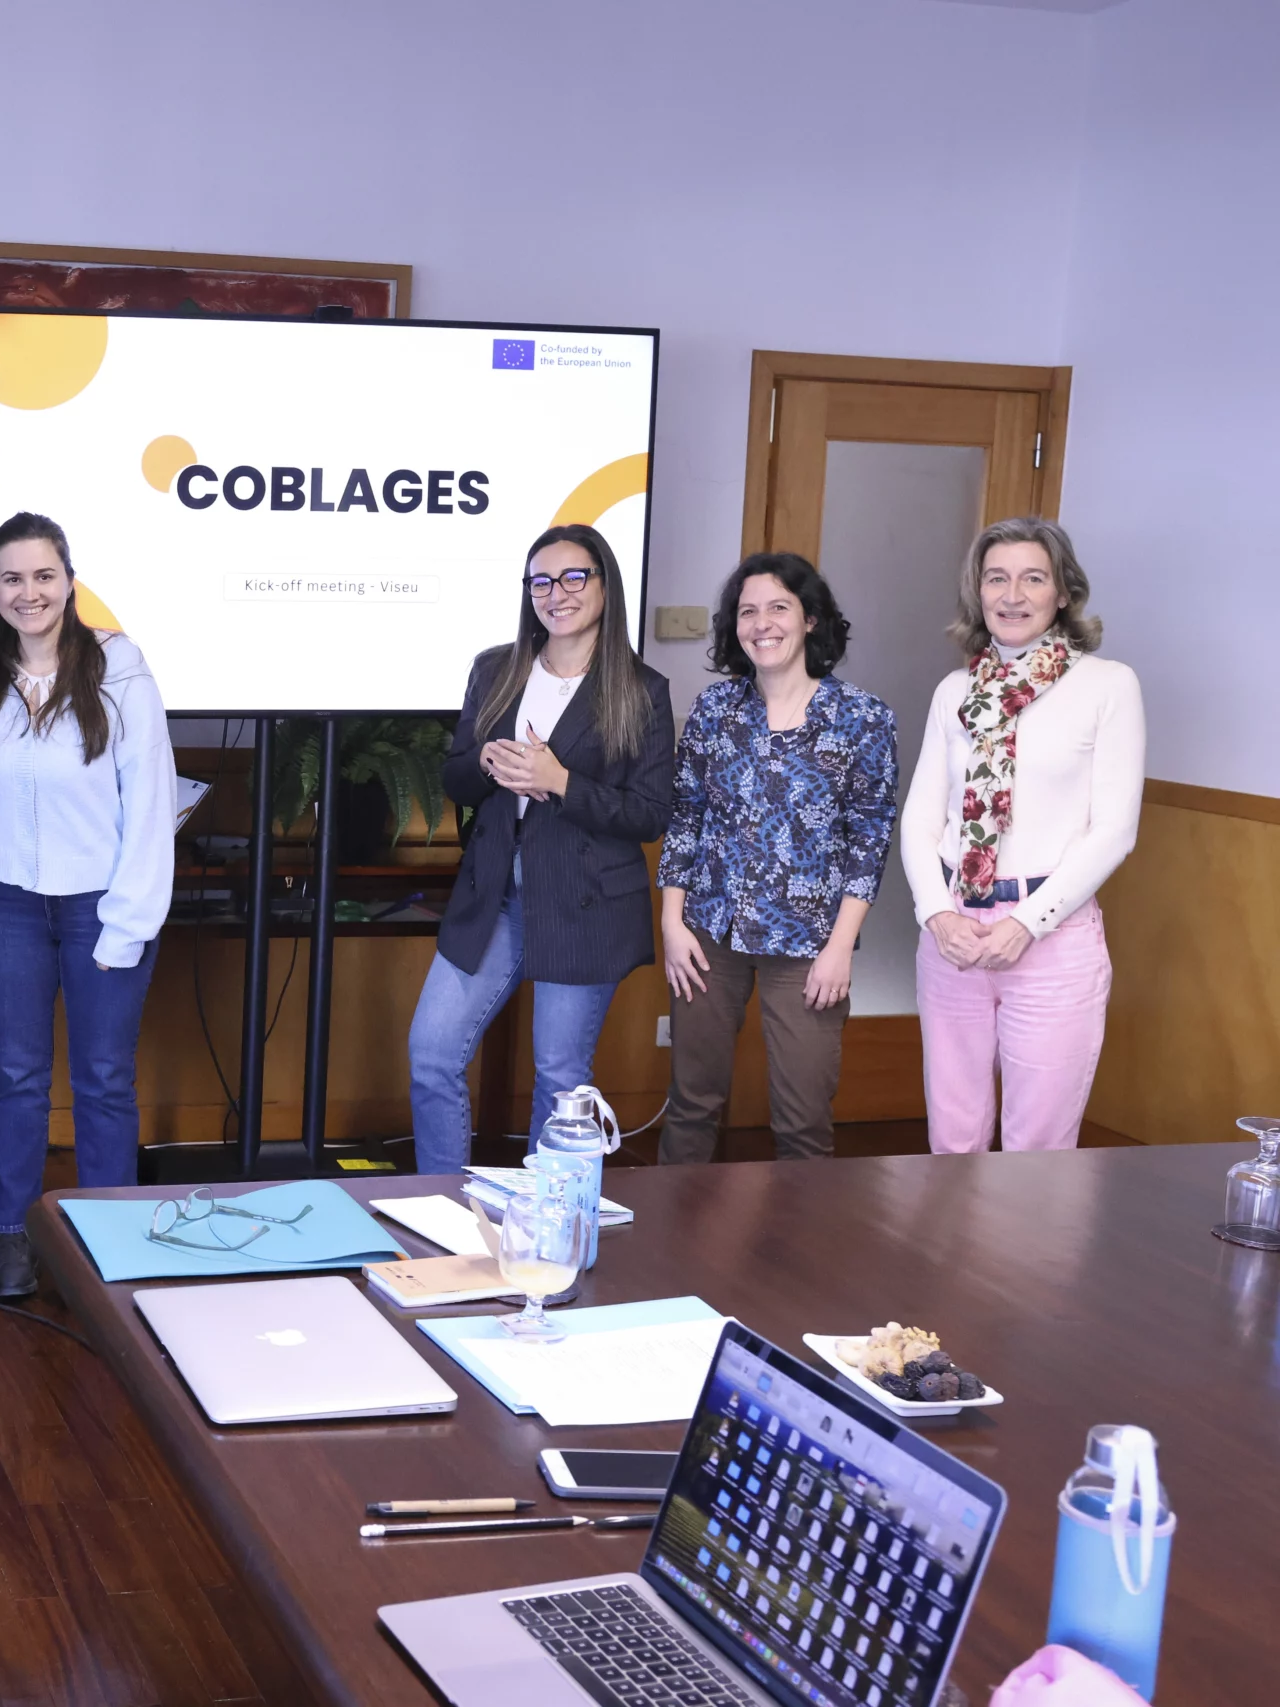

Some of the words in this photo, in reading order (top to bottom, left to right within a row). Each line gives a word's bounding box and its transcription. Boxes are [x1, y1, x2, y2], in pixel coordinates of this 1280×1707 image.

[540, 344, 589, 354] Co-funded
[591, 345, 603, 356] by
[540, 357, 555, 365] the
[557, 357, 602, 368] European
[604, 359, 632, 368] Union
[177, 464, 490, 516] COBLAGES
[245, 579, 302, 592] Kick-off
[307, 580, 365, 596] meeting
[380, 580, 419, 593] Viseu
